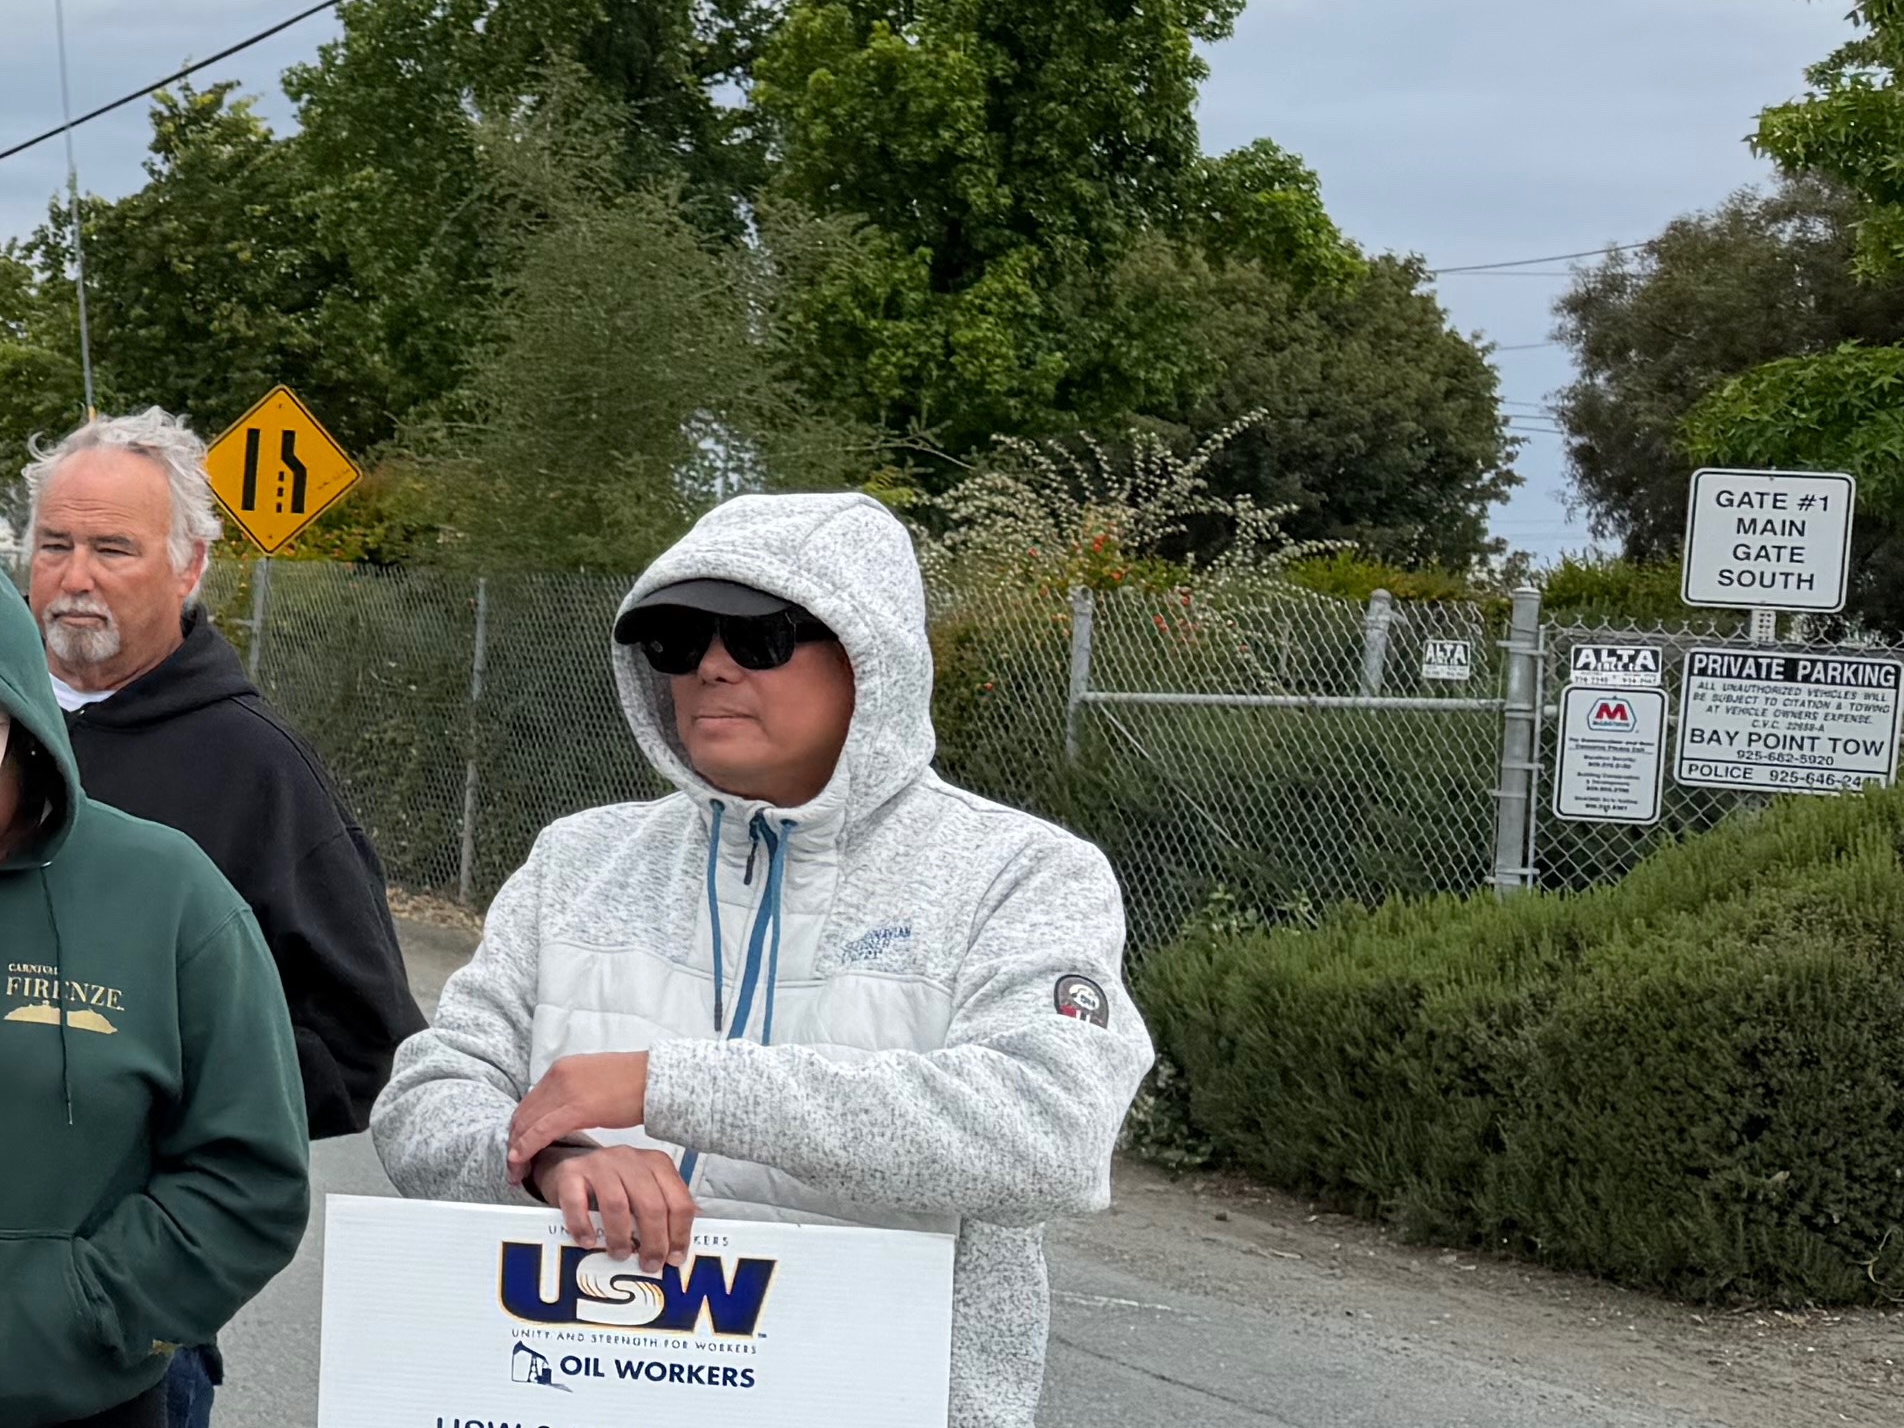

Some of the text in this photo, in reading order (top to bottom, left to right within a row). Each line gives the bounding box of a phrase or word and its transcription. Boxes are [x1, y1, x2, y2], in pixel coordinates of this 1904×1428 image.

[1716, 490, 1828, 512] GATE #1
[1737, 518, 1806, 537] MAIN
[1733, 543, 1805, 563] GATE
[1718, 569, 1814, 590] SOUTH
[1426, 644, 1466, 663] ALTA
[1576, 649, 1656, 671] ALTA
[1693, 654, 1895, 686] PRIVATE PARKING
[1697, 682, 1886, 701] ALL UNAUTHORIZED VEHICLES WILL
[1693, 693, 1706, 701] BE
[1712, 694, 1757, 704] SUBJECT
[1765, 698, 1777, 706] TO
[1783, 699, 1831, 710] CITATION
[1850, 703, 1890, 713] TOWING
[1706, 705, 1720, 713] AT
[1726, 706, 1768, 716] VEHICLE
[1774, 710, 1819, 720] OWNERS
[1690, 728, 1884, 756] BAY POINT TOW
[1737, 750, 1834, 765] 925-682-5920
[1688, 764, 1880, 787] POLICE 925-646-24
[498, 1241, 777, 1337] USW
[560, 1355, 755, 1388] OIL WORKERS
